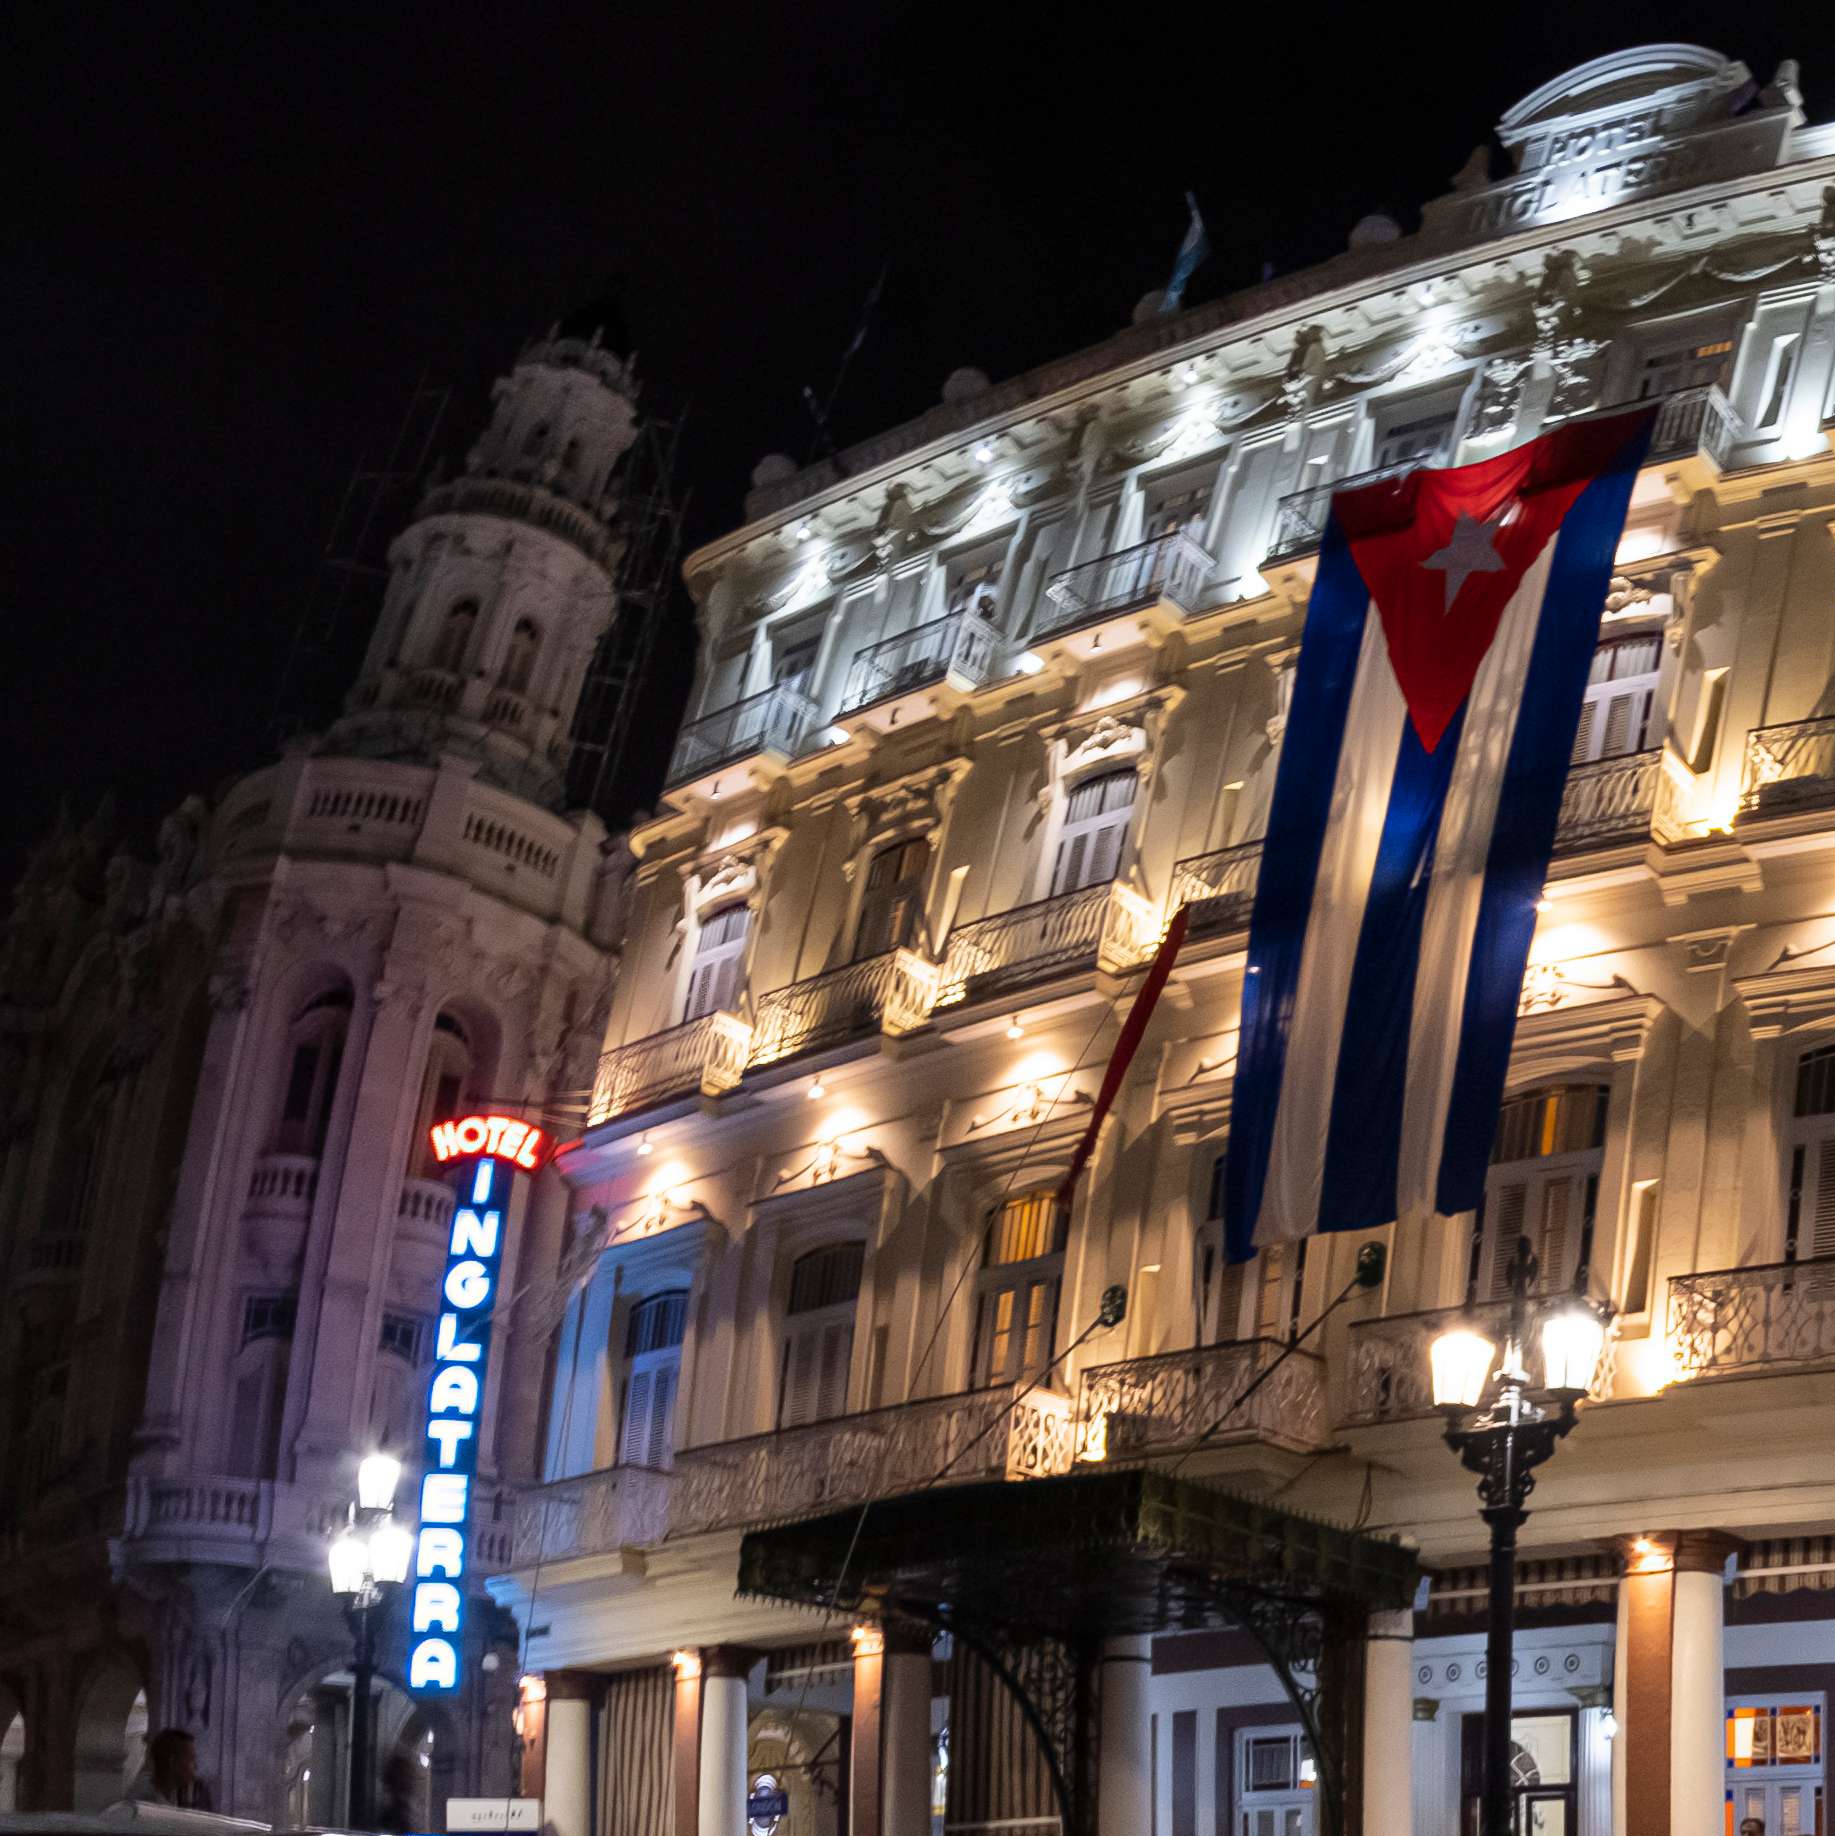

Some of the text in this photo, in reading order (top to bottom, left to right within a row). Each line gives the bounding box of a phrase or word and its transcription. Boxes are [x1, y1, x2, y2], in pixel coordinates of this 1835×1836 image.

[1548, 109, 1667, 161] HOTEL
[1467, 144, 1718, 233] INGLATER
[431, 1116, 543, 1169] HOTEL
[409, 1157, 502, 1690] INGLATERRA
